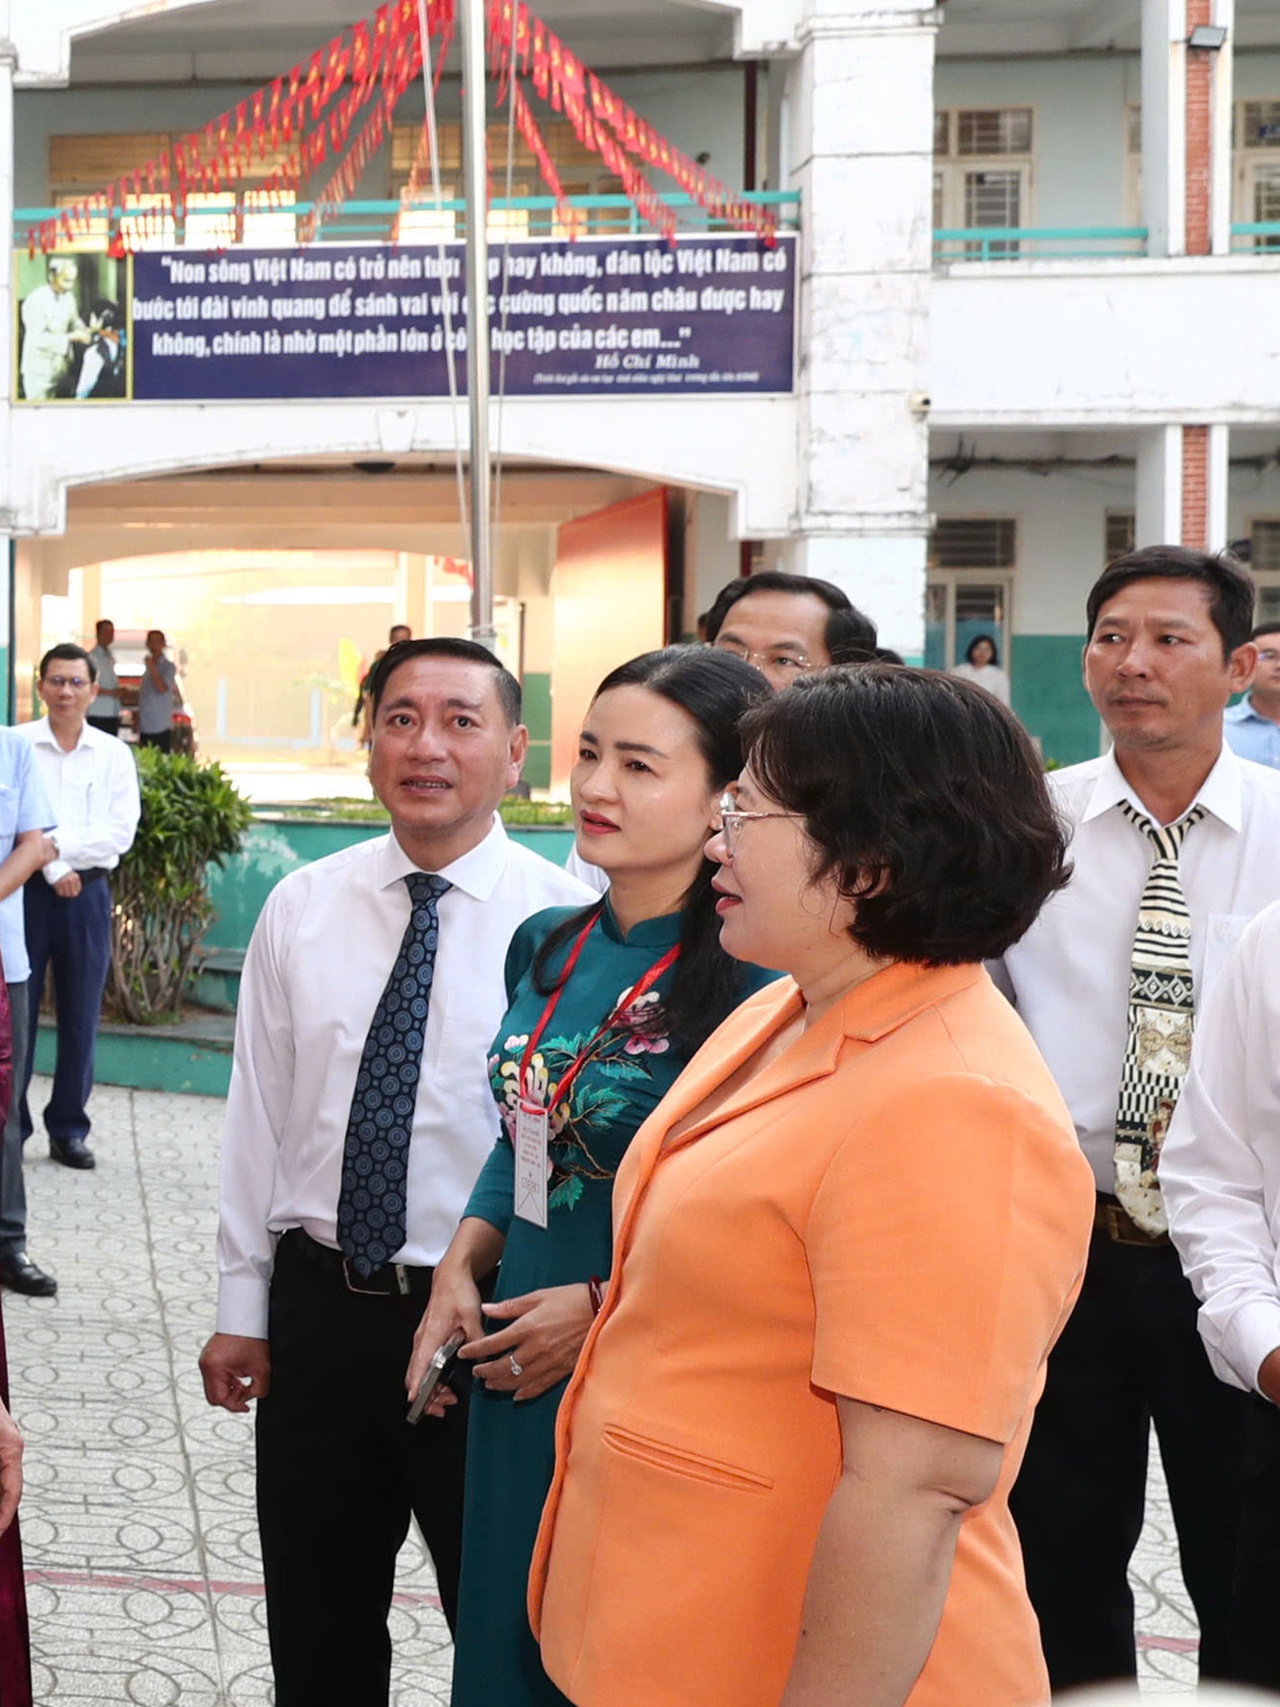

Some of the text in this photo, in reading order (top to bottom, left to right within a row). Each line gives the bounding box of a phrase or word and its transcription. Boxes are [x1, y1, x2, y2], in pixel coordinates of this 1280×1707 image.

[208, 259, 251, 286] sông
[253, 257, 288, 287] Việt
[290, 257, 332, 281] Nam
[334, 255, 357, 281] có
[387, 254, 422, 279] nên
[540, 250, 603, 278] không,
[644, 249, 674, 278] tộc
[677, 248, 713, 278] Việt
[715, 248, 759, 273] Nam
[762, 246, 787, 273] có
[231, 296, 269, 319] vinh
[271, 298, 326, 321] quang
[354, 292, 398, 317] sánh
[400, 292, 428, 316] vai
[558, 285, 603, 315] quốc
[651, 286, 698, 312] châu
[749, 286, 785, 313] hay
[152, 331, 211, 358] không,
[212, 330, 262, 355] chính
[264, 328, 282, 354] là
[318, 328, 352, 357] một
[527, 325, 557, 355] tập
[559, 322, 593, 349] của
[594, 323, 629, 349] các
[622, 352, 653, 369] Chí
[655, 352, 700, 369] Minh
